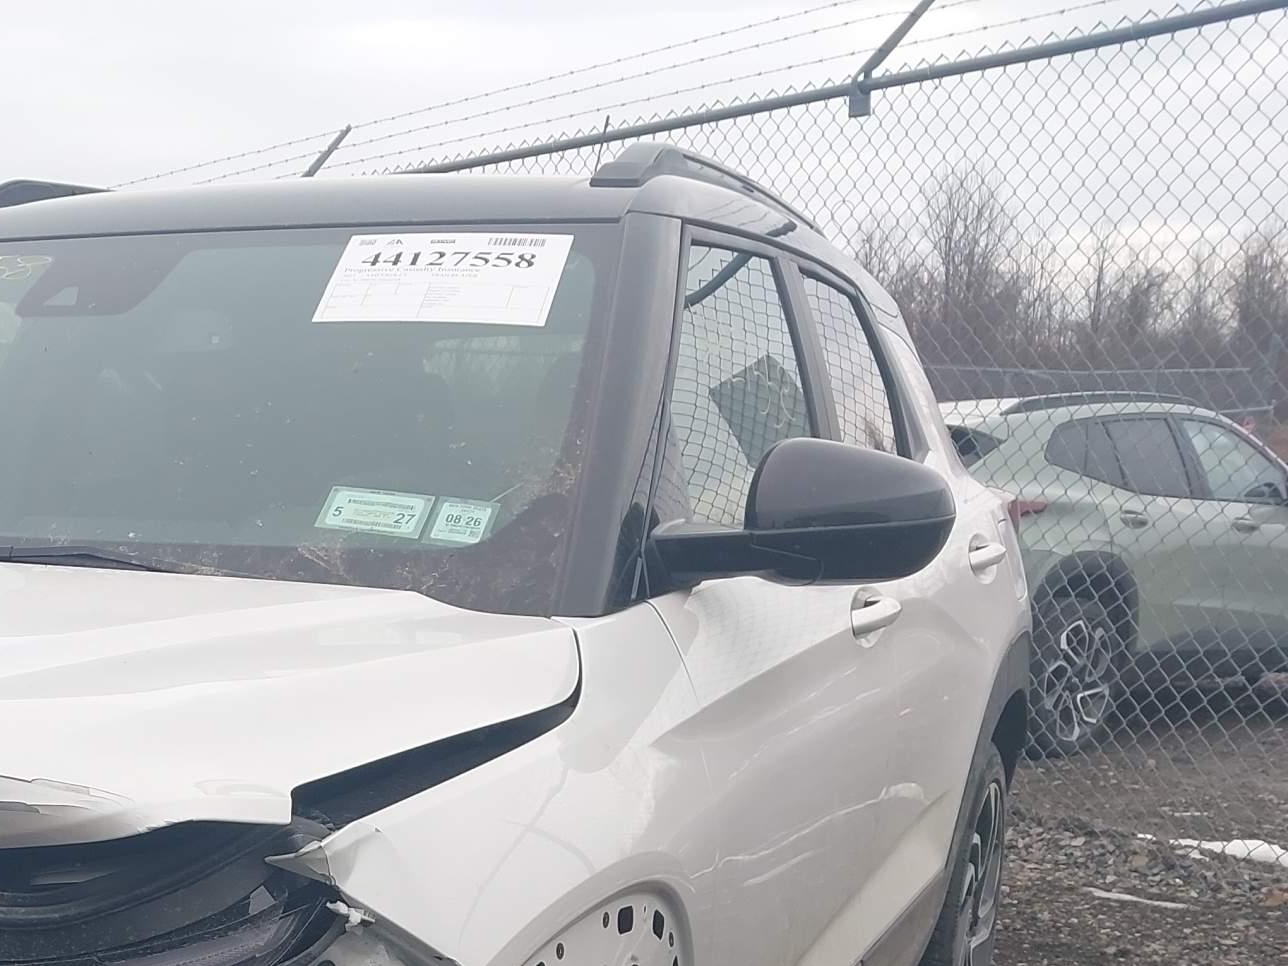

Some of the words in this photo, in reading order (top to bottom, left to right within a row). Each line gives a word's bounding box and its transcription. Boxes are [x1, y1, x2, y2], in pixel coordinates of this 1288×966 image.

[361, 250, 537, 269] 44127558
[332, 506, 344, 517] 5
[393, 512, 417, 525] 27
[445, 513, 462, 524] 08
[465, 516, 482, 527] 26
